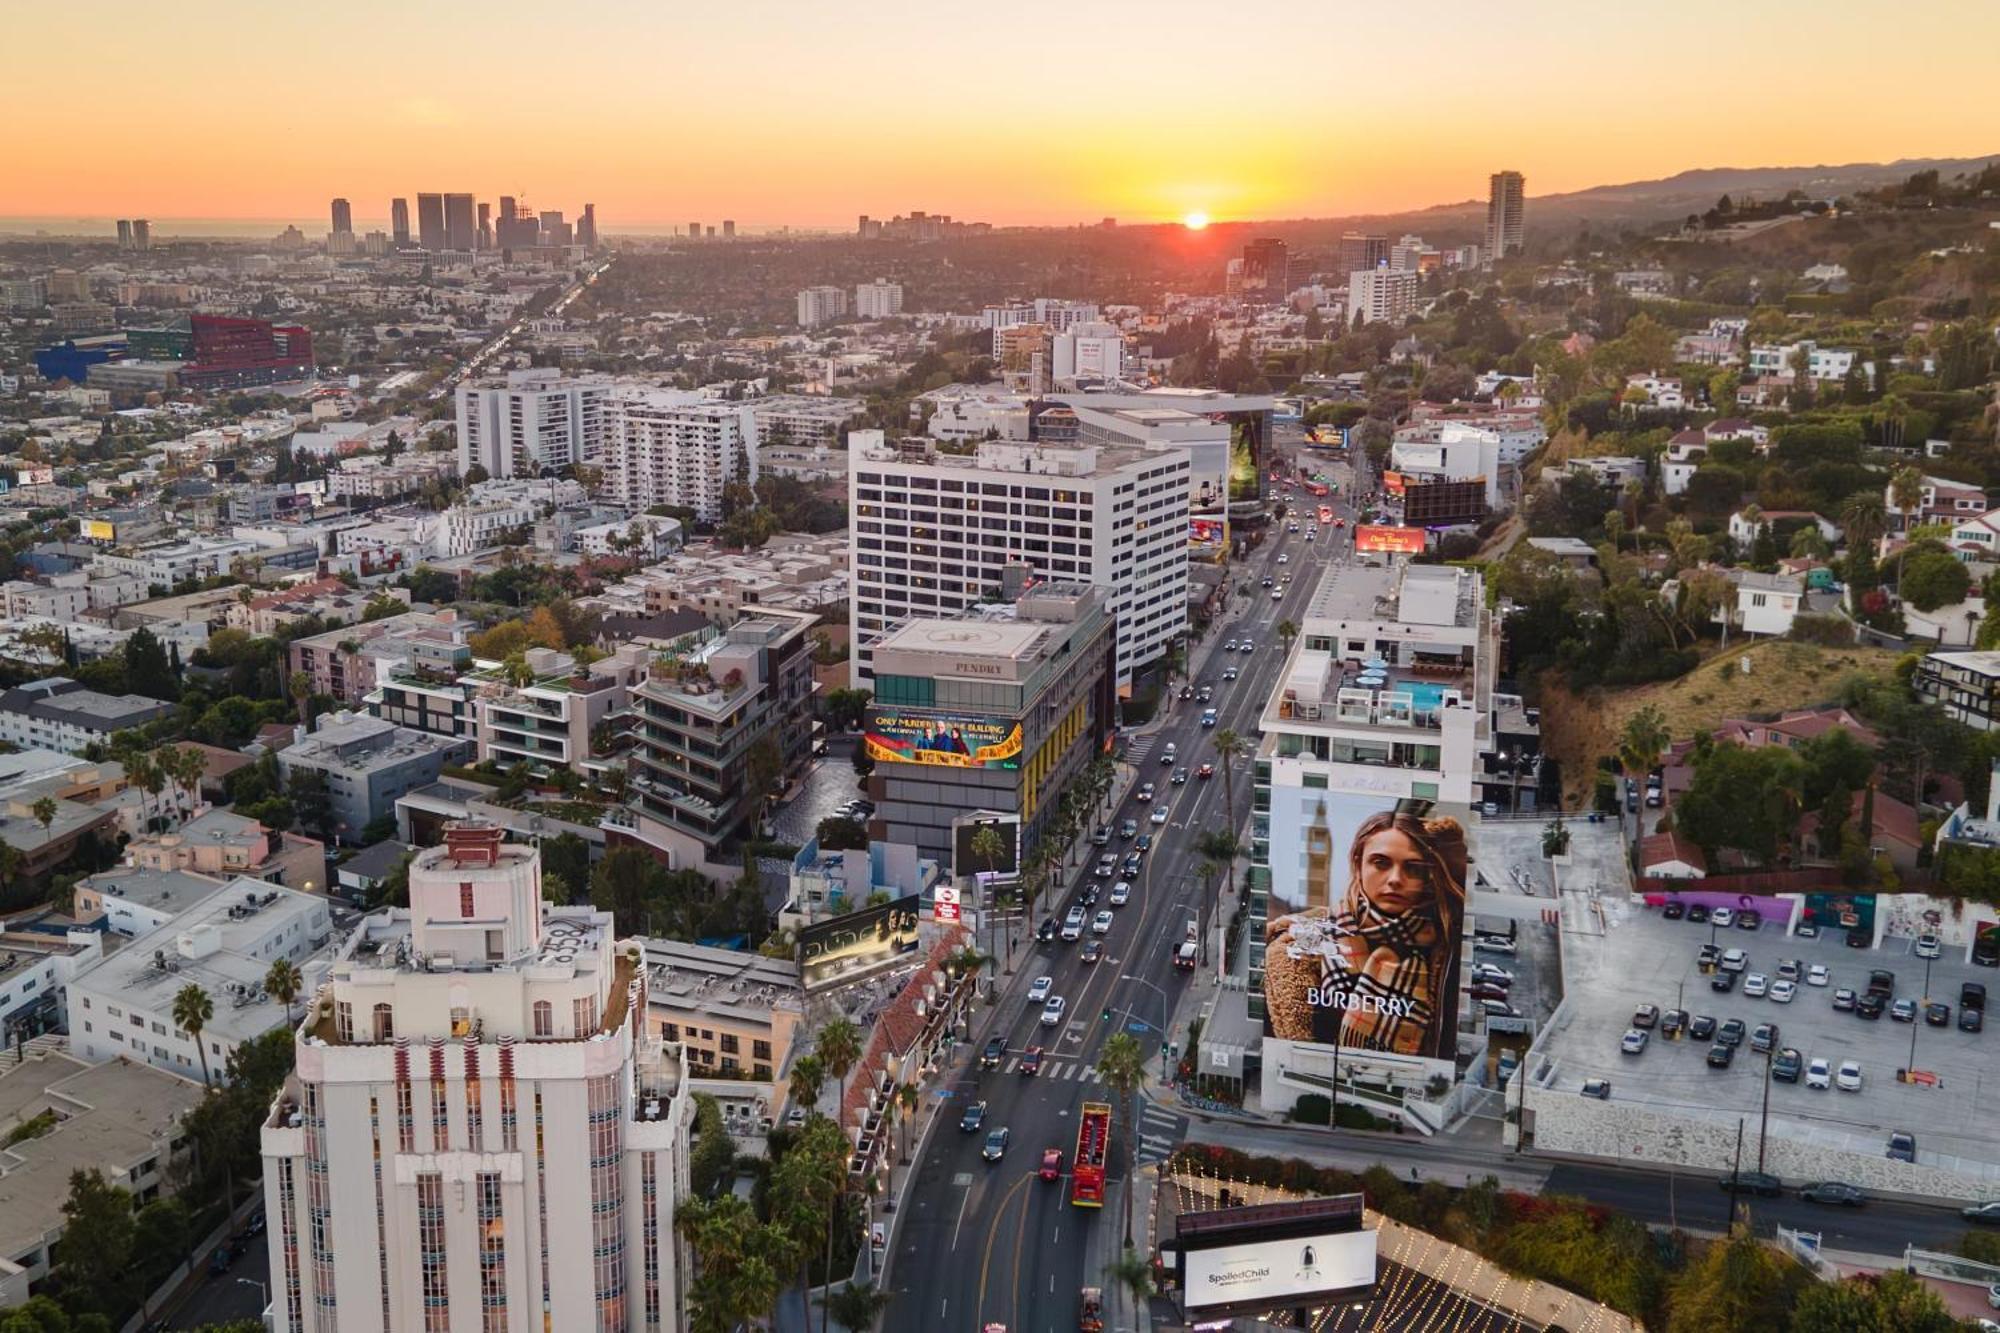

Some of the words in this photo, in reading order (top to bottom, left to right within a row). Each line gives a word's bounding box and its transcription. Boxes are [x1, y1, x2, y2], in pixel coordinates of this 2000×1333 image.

[956, 663, 1002, 674] PENDRY
[875, 716, 898, 726] ONLY
[967, 722, 1005, 735] BUILDING
[1307, 987, 1416, 1017] BURBERRY
[1208, 1267, 1270, 1283] SpoiledChild
